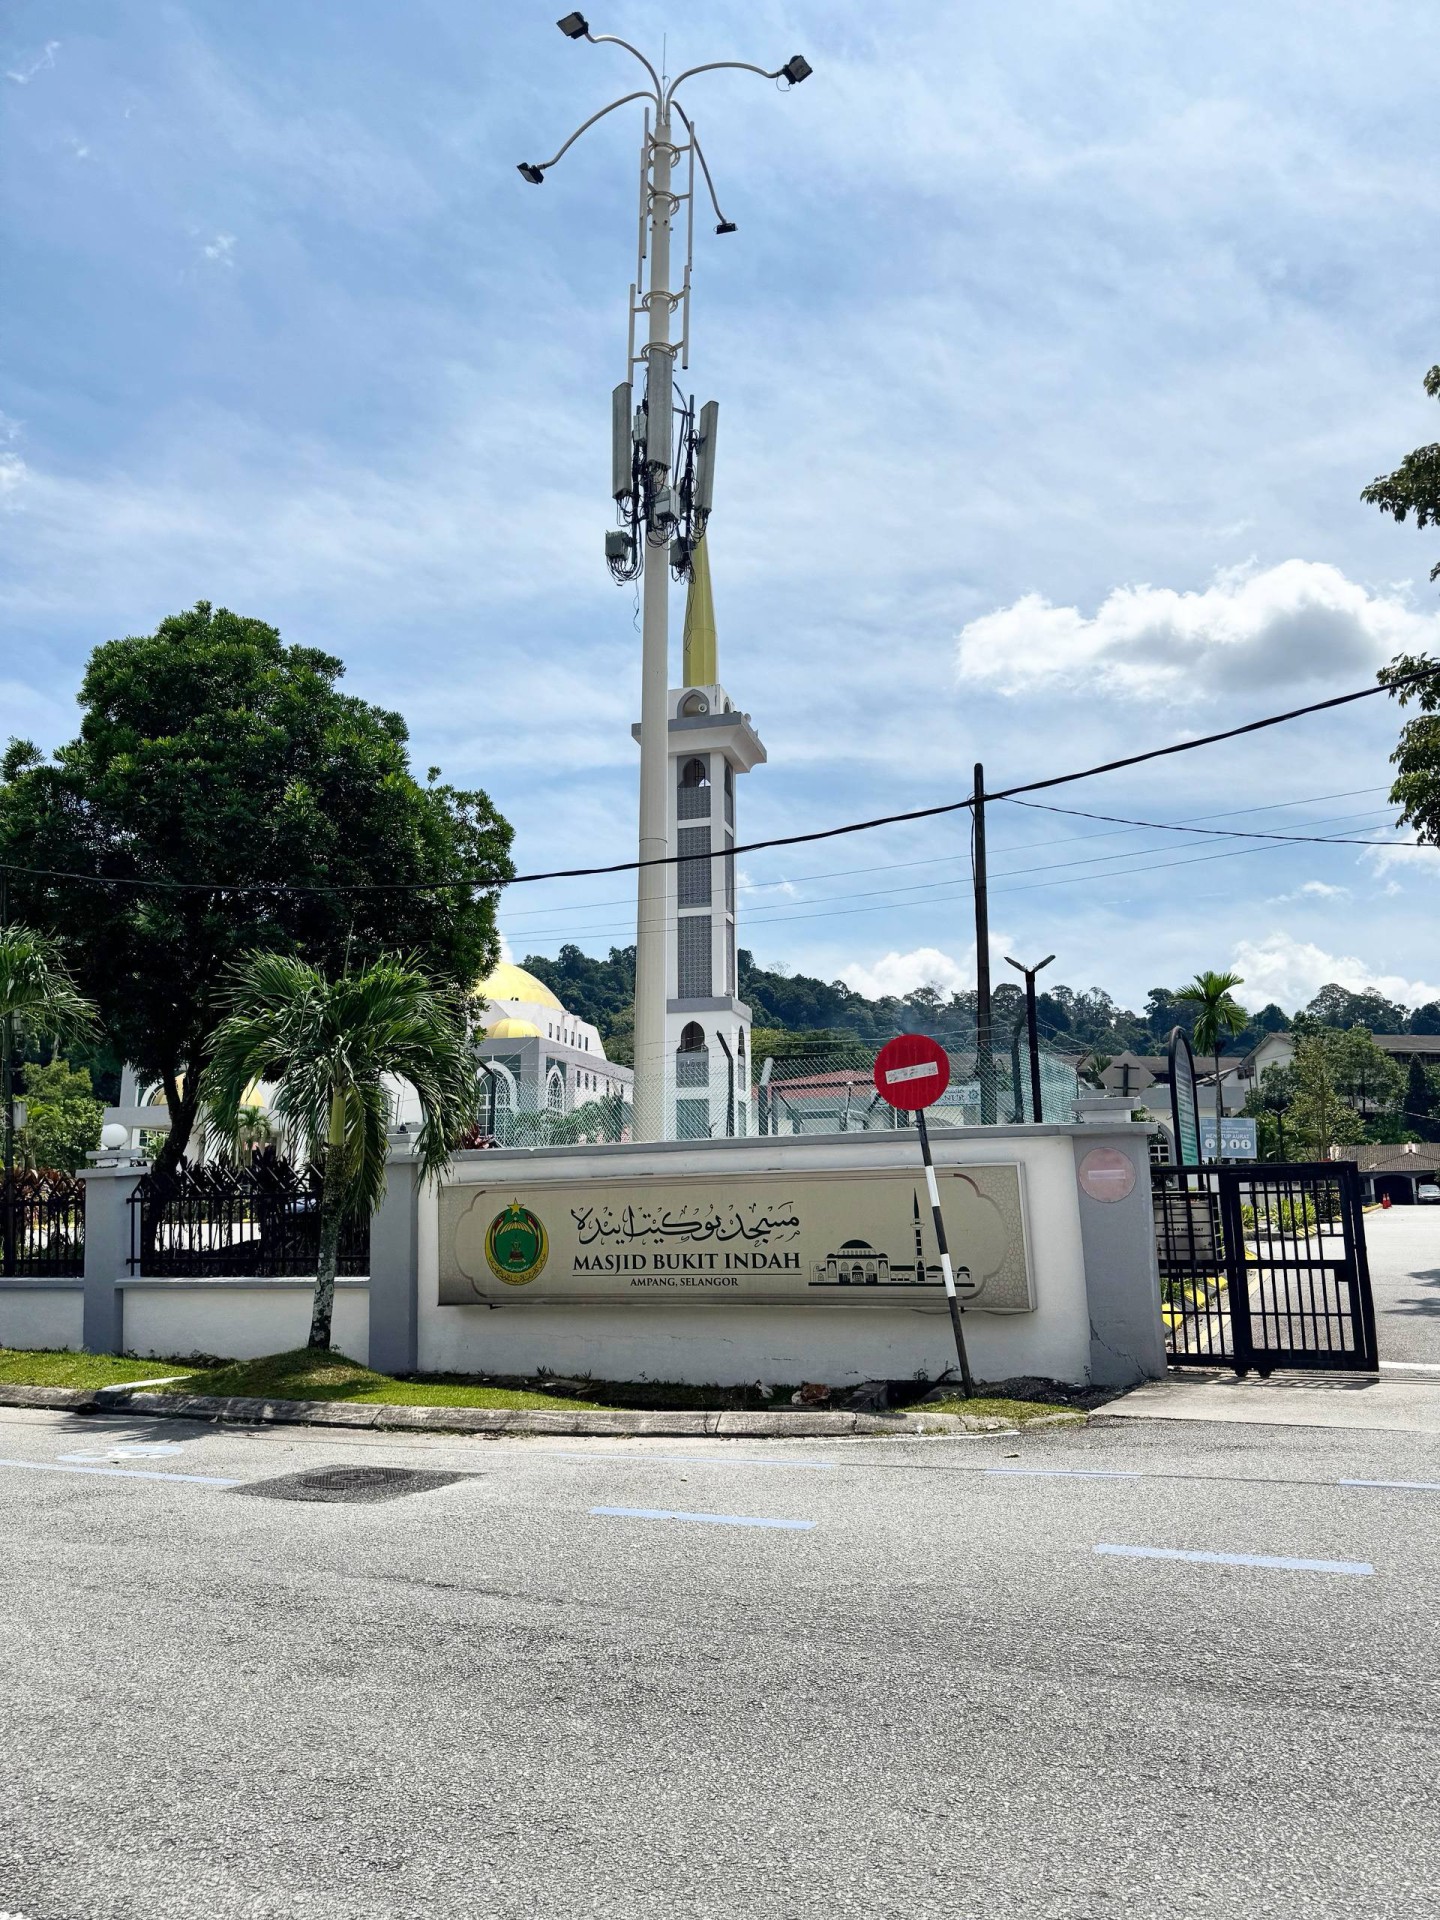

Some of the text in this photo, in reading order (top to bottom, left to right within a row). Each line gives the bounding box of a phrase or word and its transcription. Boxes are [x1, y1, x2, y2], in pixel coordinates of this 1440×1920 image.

[573, 1252, 801, 1274] MASJID BUKIT INDAH
[630, 1277, 739, 1287] AMPANG, SELANGOR
